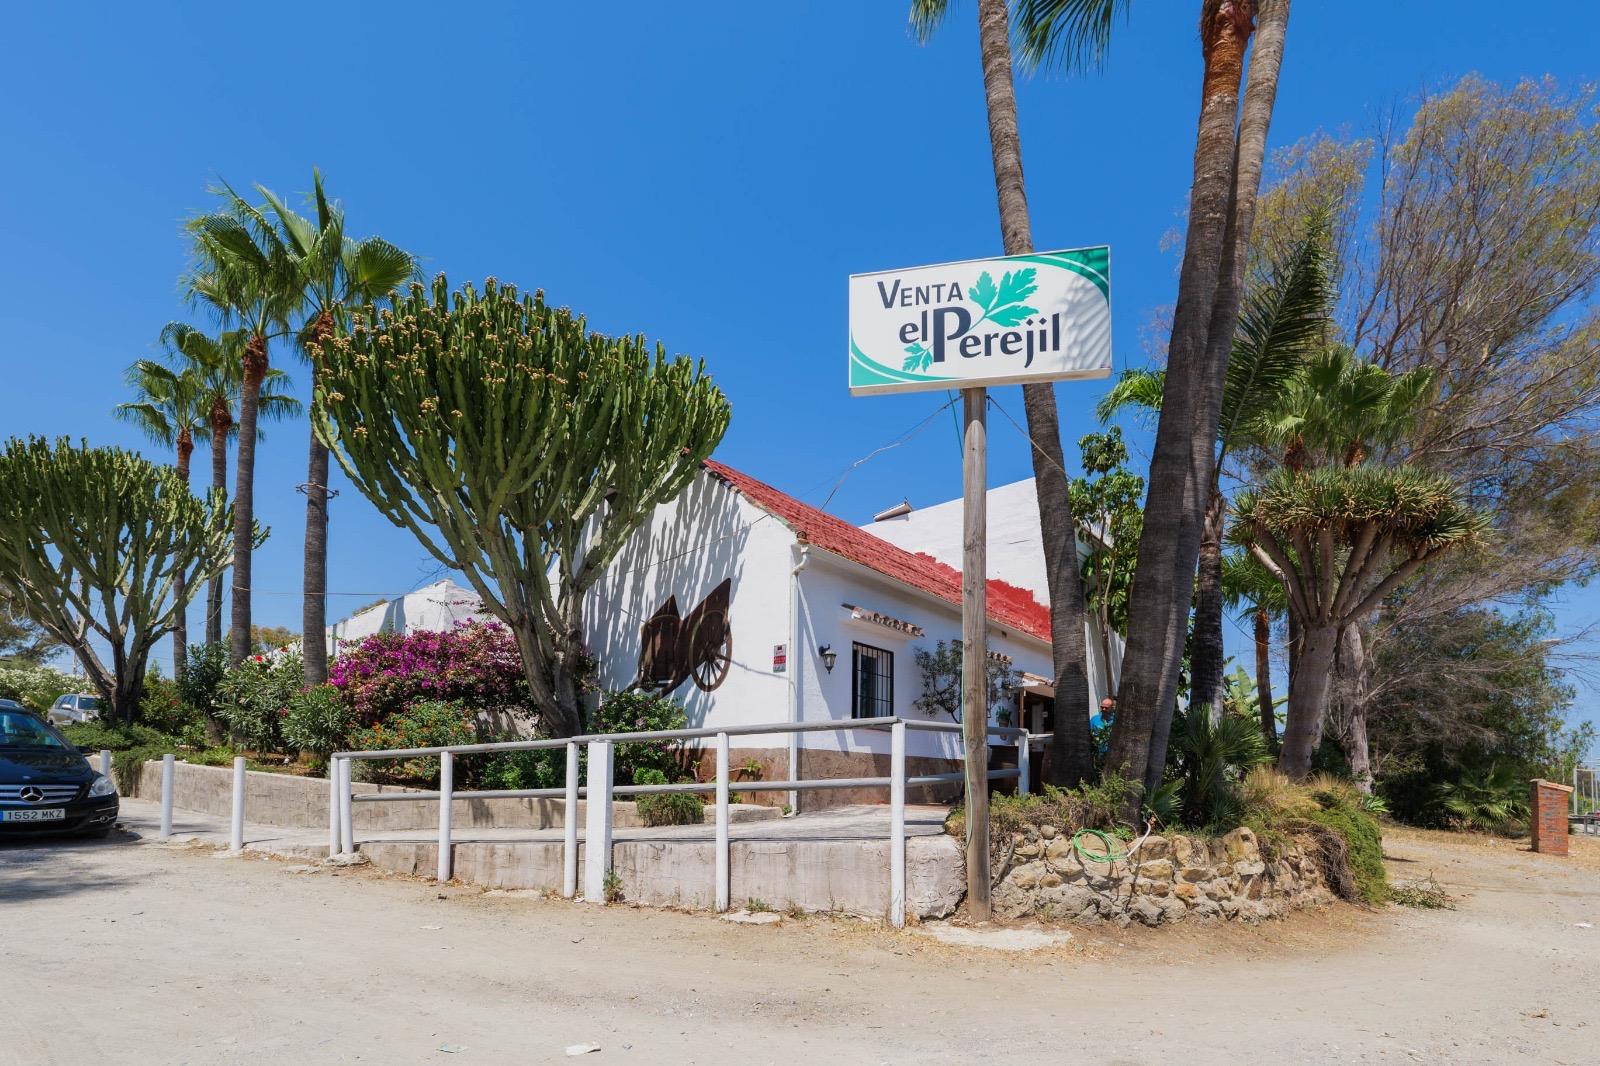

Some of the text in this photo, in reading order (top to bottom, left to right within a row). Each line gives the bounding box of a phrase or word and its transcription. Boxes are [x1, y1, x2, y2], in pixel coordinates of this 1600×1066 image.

[877, 279, 963, 308] VENTA
[899, 306, 1060, 368] el Perejil
[7, 810, 62, 819] 1552 MKZ
